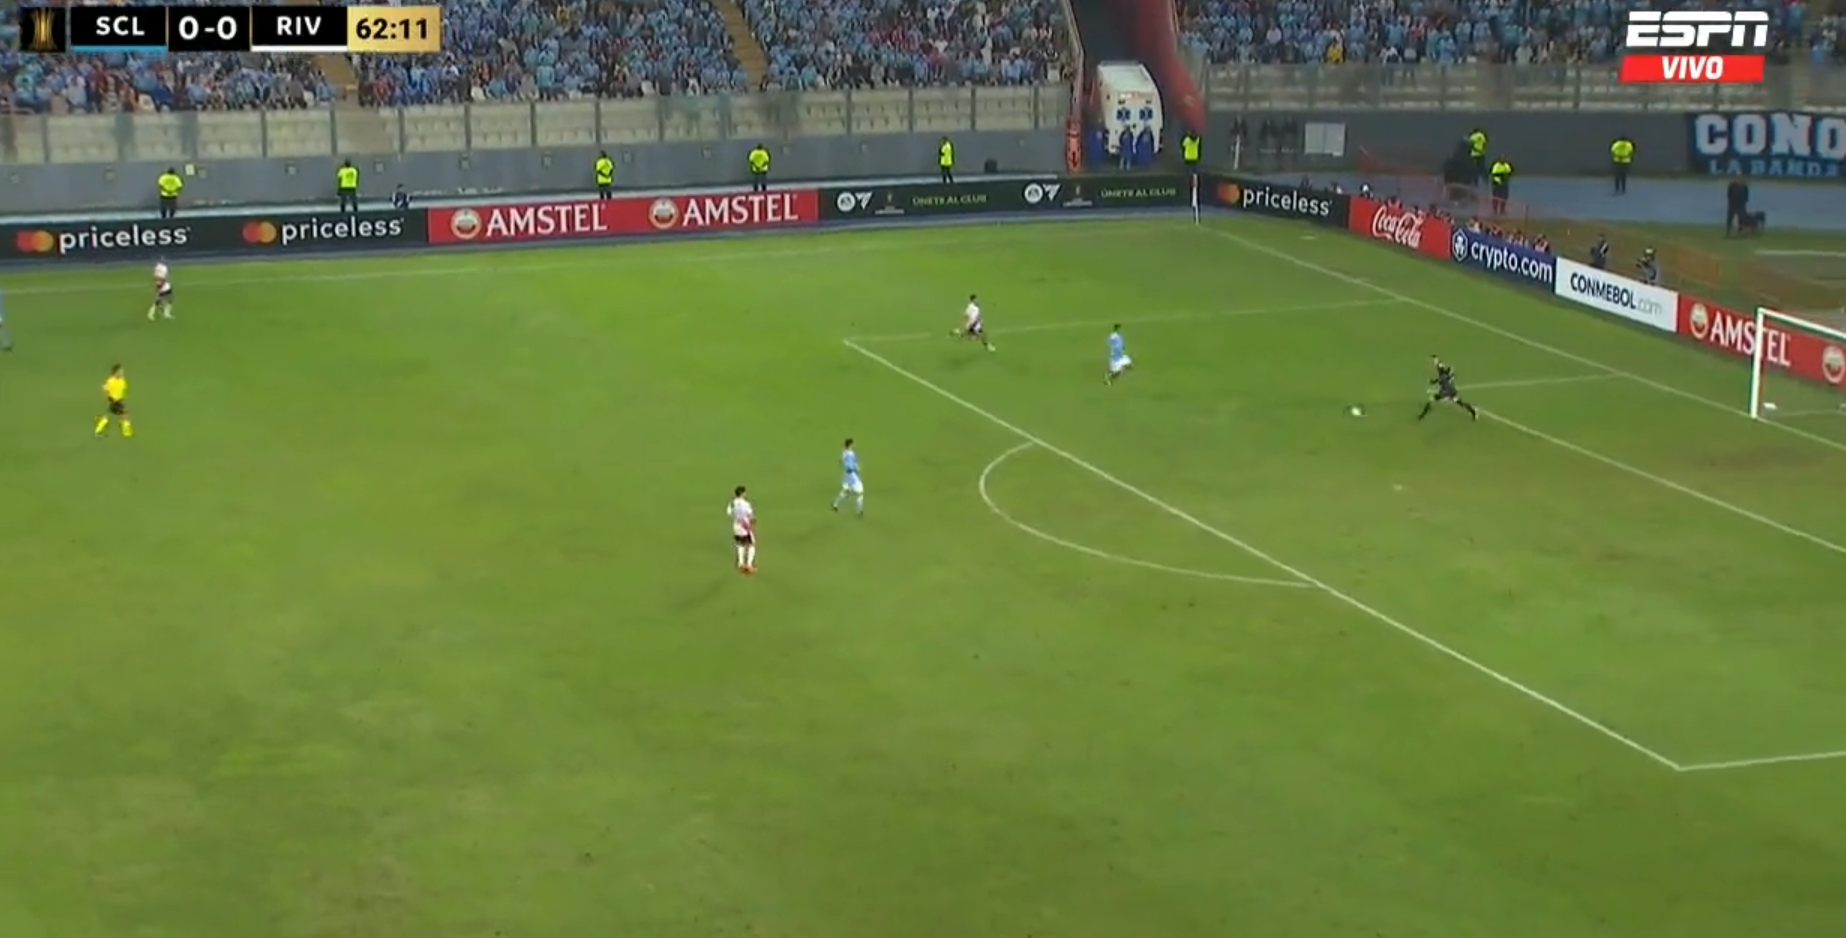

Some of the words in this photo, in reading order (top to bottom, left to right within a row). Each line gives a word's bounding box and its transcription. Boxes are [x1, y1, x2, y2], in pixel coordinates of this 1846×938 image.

[1709, 159, 1742, 175] LA
[682, 193, 799, 227] AMSTEL
[1243, 186, 1330, 216] priceless
[281, 215, 402, 245] priceless
[486, 203, 608, 237] AMSTEL
[59, 224, 188, 254] priceless
[1471, 241, 1552, 283] crypto.com
